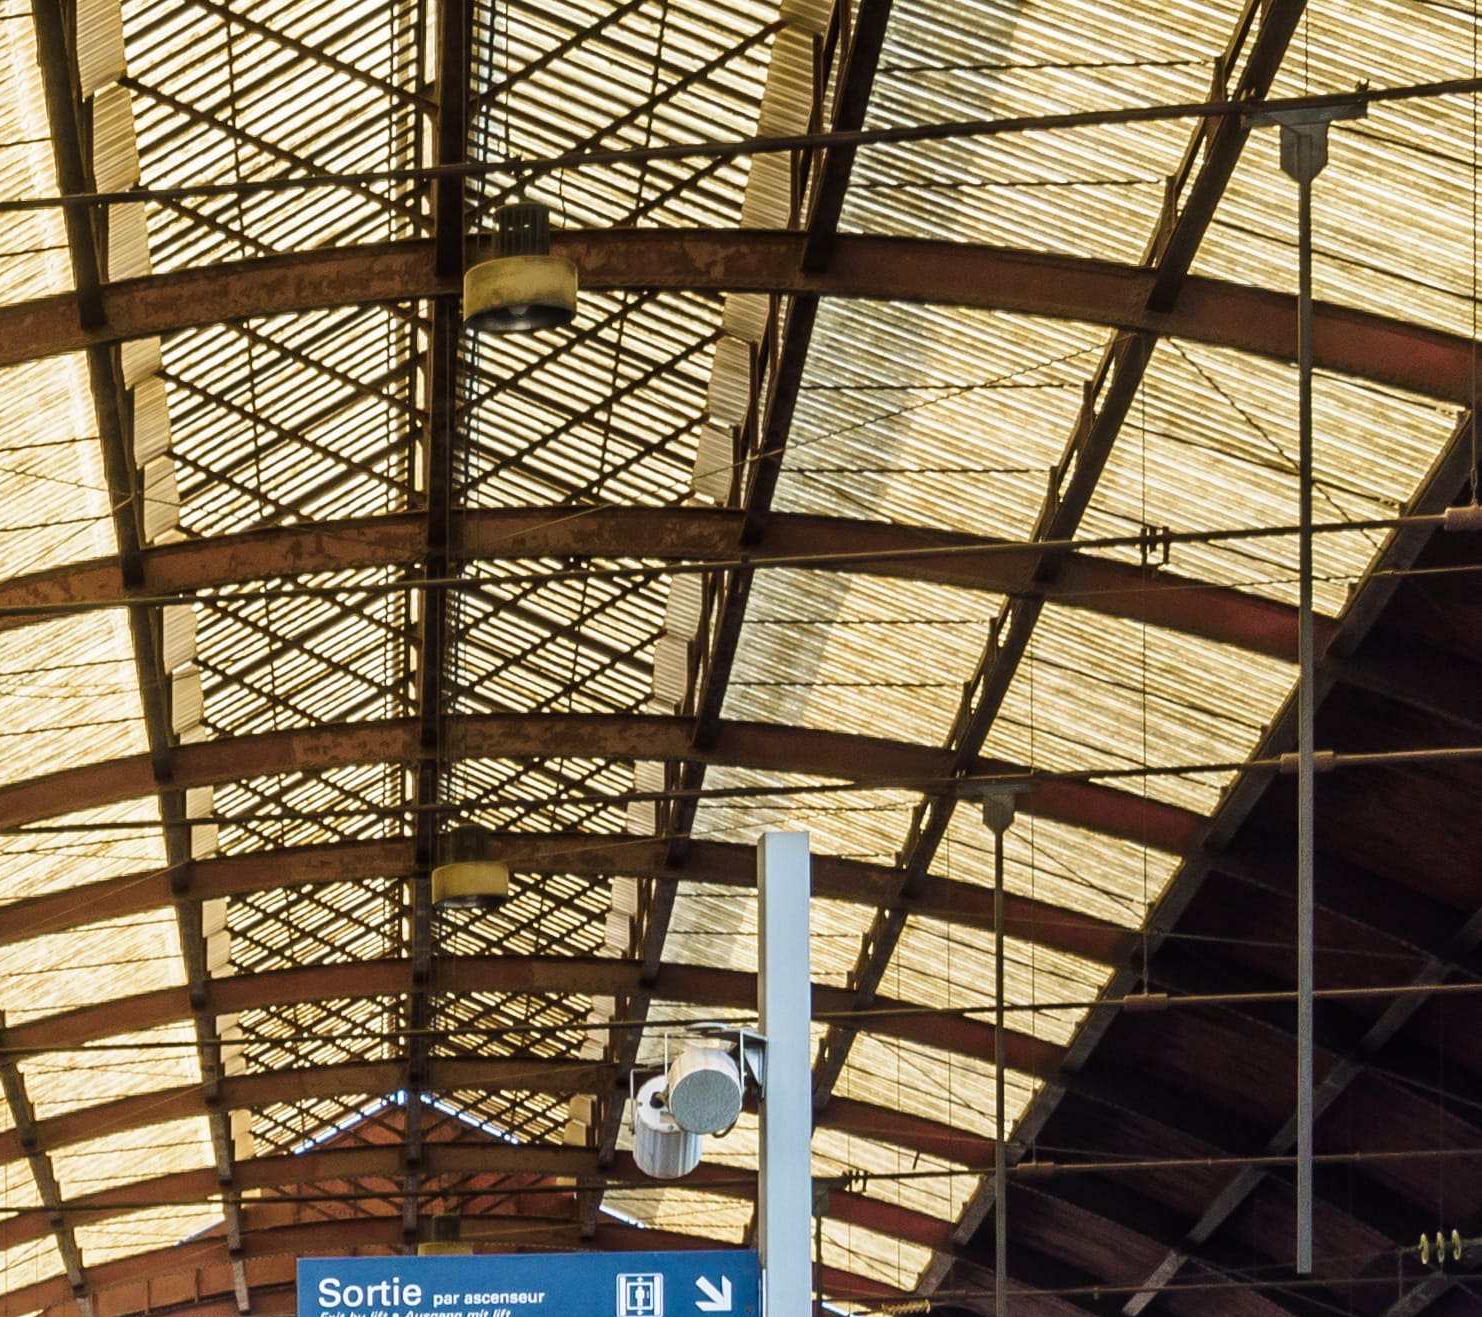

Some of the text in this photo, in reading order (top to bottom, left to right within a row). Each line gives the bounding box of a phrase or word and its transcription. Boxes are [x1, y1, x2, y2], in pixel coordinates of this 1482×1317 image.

[318, 1276, 546, 1308] Sortie par ascenseur
